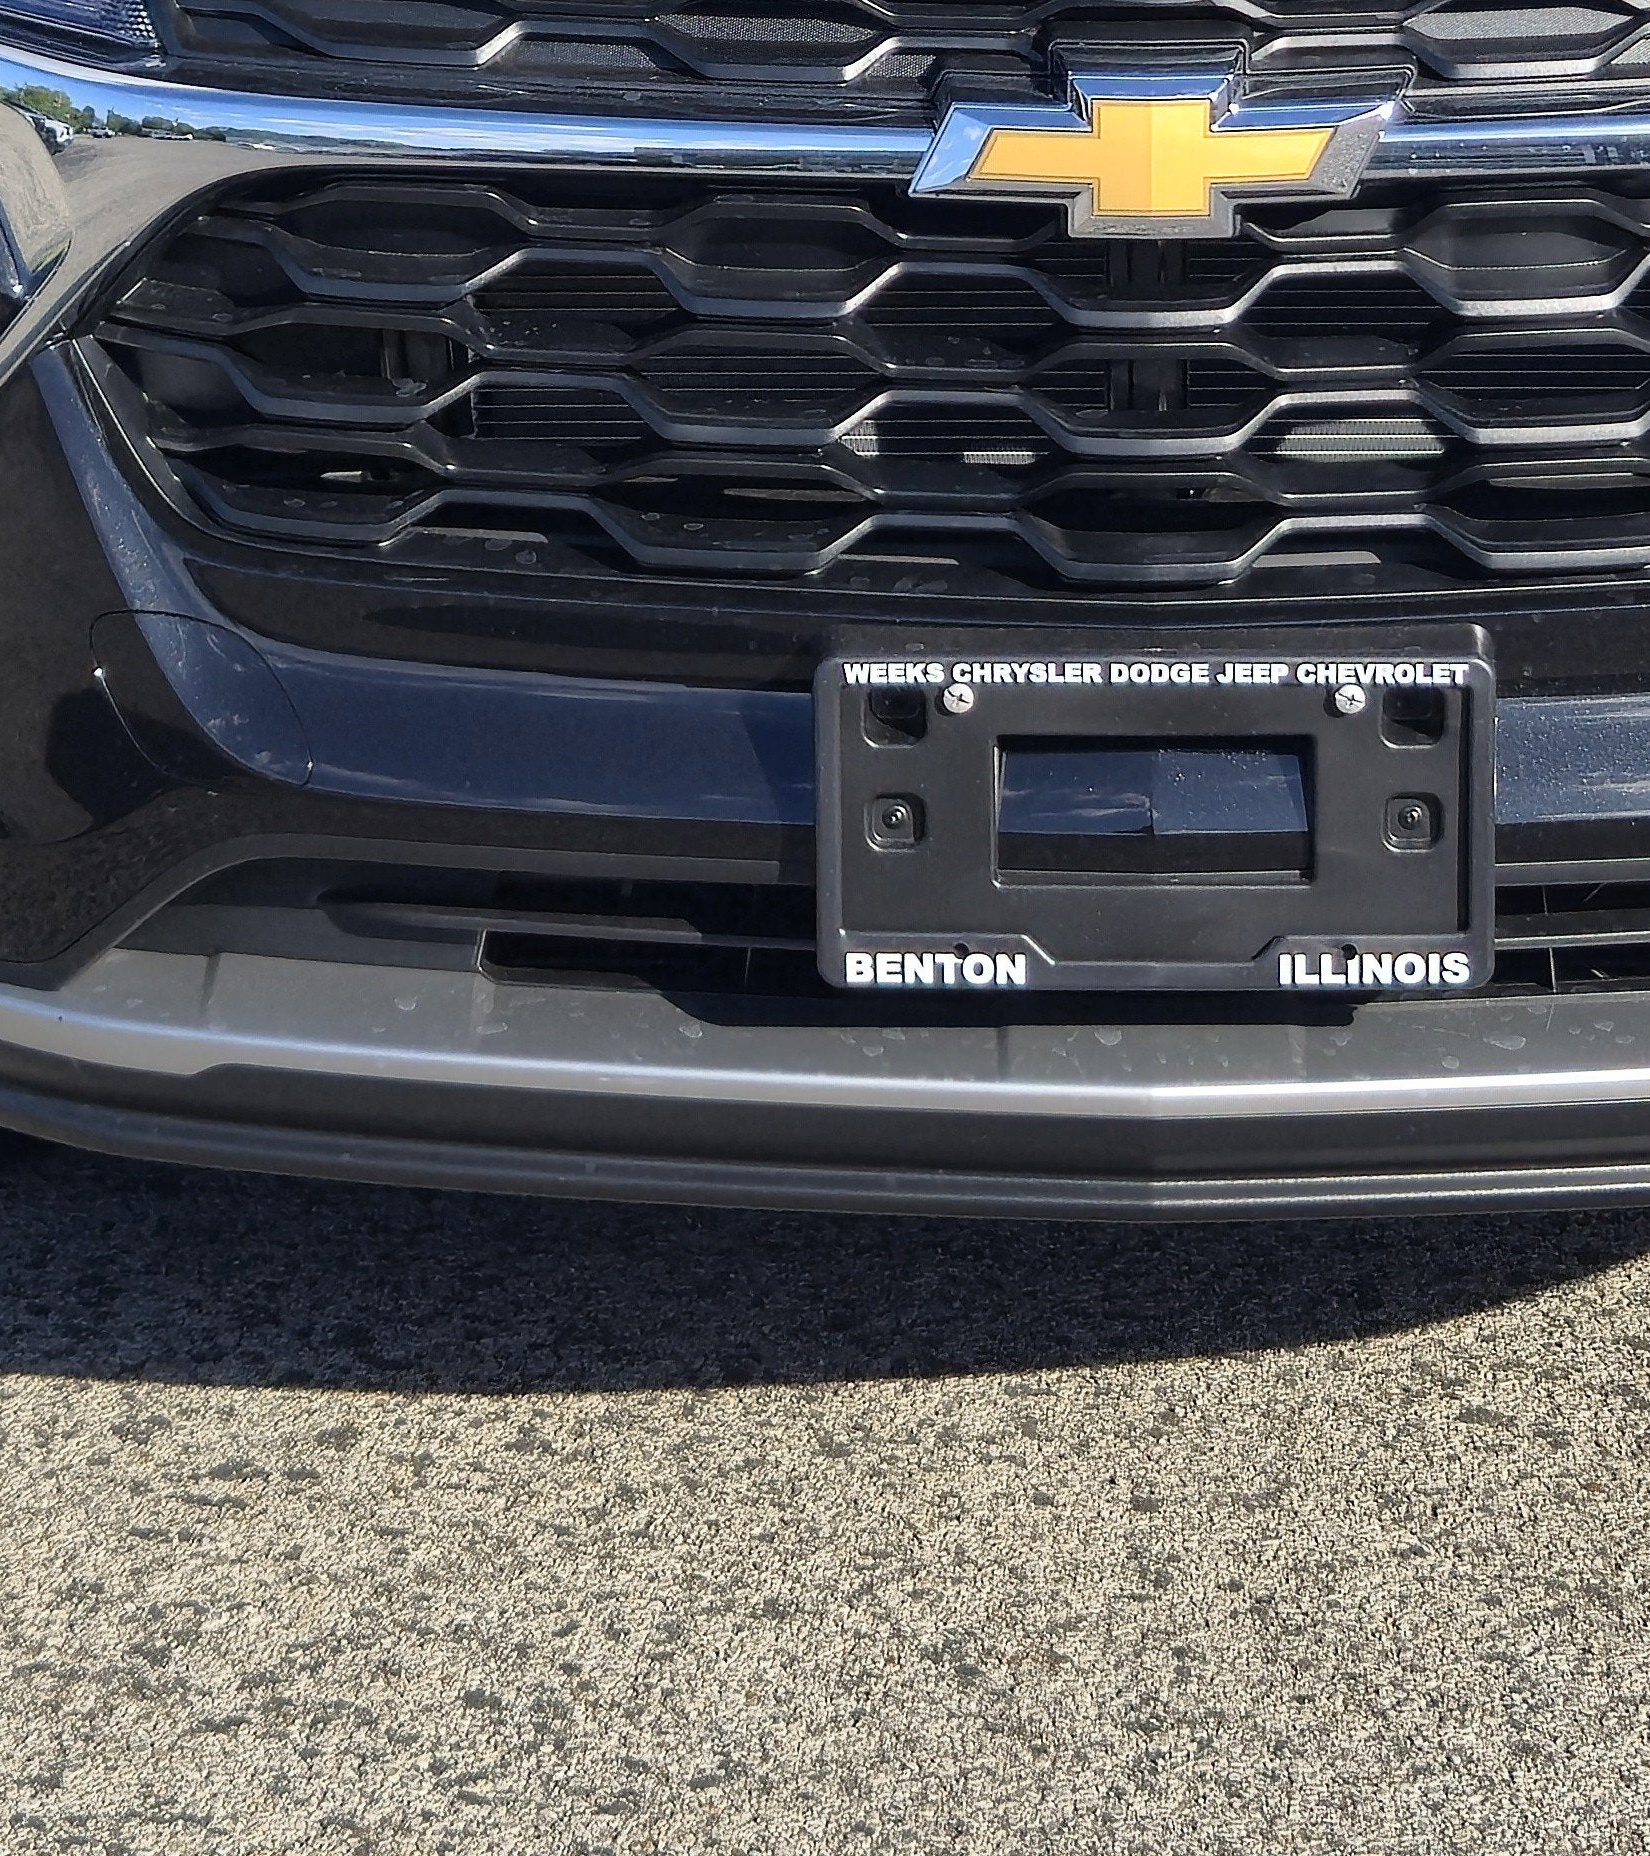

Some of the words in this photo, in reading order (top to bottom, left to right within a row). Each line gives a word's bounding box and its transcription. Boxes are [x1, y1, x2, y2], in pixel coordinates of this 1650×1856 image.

[843, 662, 945, 684] WEEKS
[952, 662, 1103, 684] CHRYSLER
[1109, 662, 1210, 684] DODGE
[1215, 662, 1289, 684] JEEP
[1296, 662, 1470, 684] CHEVROLET
[845, 952, 1027, 985] BENTON
[1278, 952, 1470, 985] ILLINOIS
